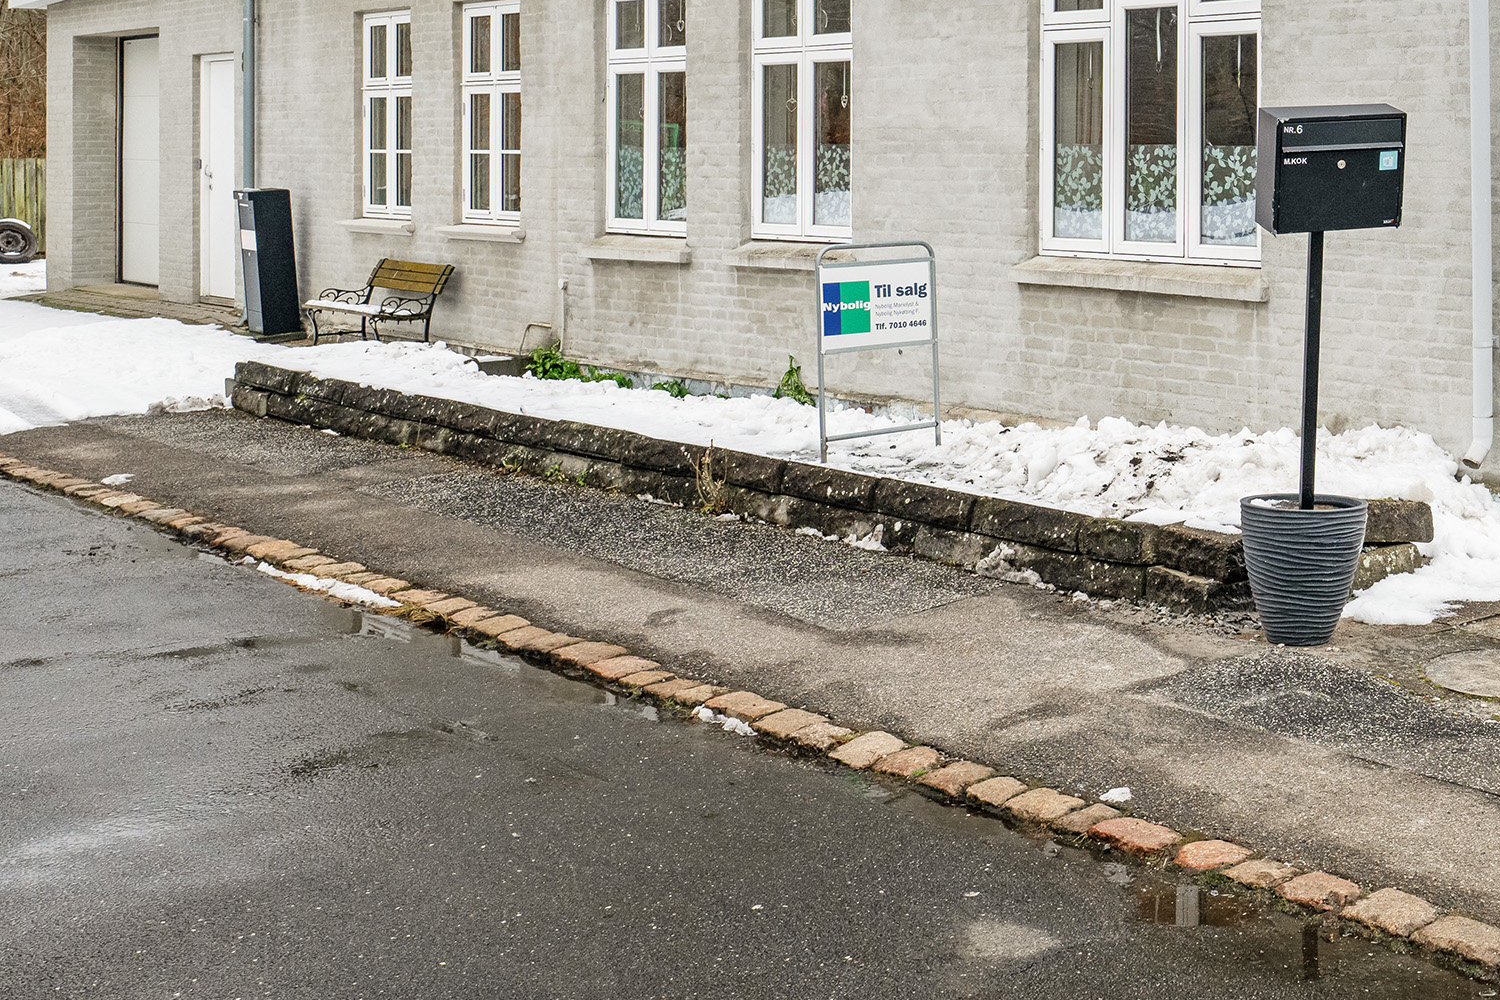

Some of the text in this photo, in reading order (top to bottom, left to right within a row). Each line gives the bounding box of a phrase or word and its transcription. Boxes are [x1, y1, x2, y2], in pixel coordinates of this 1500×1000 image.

[1283, 157, 1308, 165] M.KOK
[874, 282, 928, 298] Til salg
[823, 300, 871, 313] Nybolig
[875, 319, 927, 330] Tlf. 7010 4646
